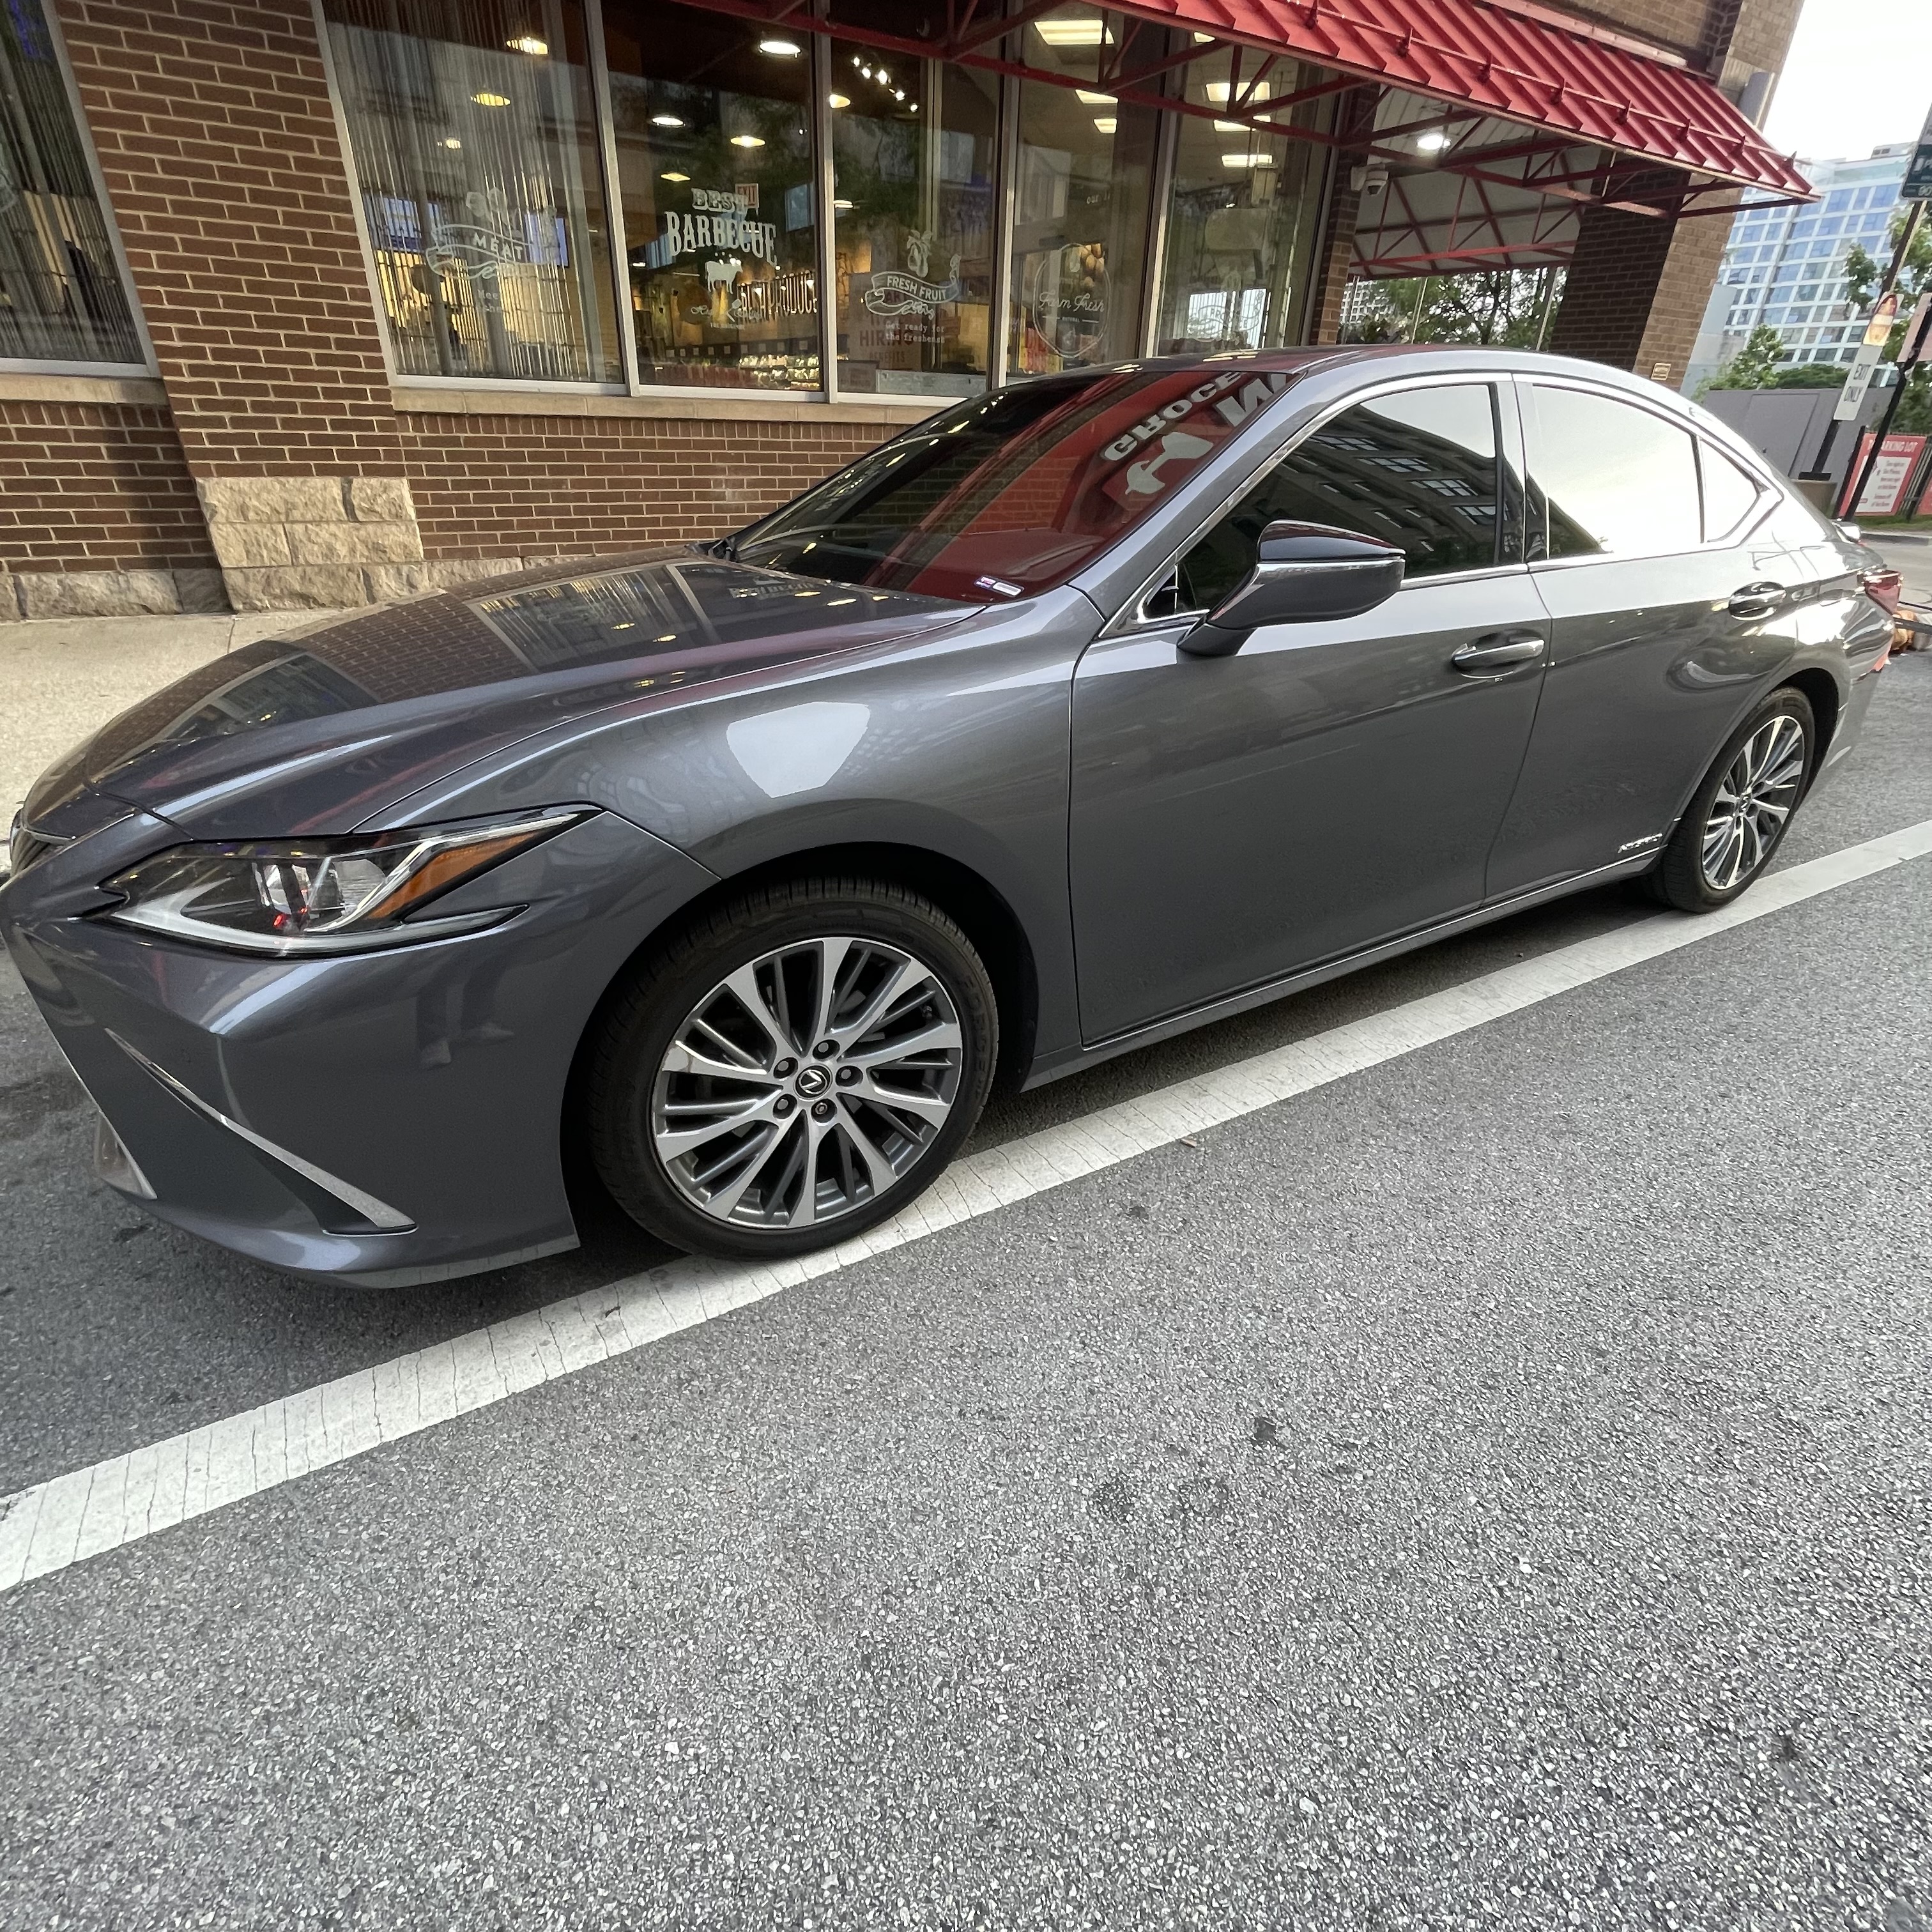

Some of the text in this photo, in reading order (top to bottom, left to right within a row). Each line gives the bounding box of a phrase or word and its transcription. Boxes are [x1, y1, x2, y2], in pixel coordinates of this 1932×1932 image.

[691, 188, 749, 215] BEST
[472, 232, 523, 260] MEAT
[664, 211, 776, 268] BARBECUE
[887, 275, 917, 293] FRESH
[919, 286, 946, 300] FRUIT
[1038, 291, 1105, 312] Farm Fresh
[885, 321, 900, 330] Get
[905, 323, 928, 334] ready
[931, 324, 945, 333] for
[1211, 308, 1248, 328] PROE
[885, 331, 900, 341] the
